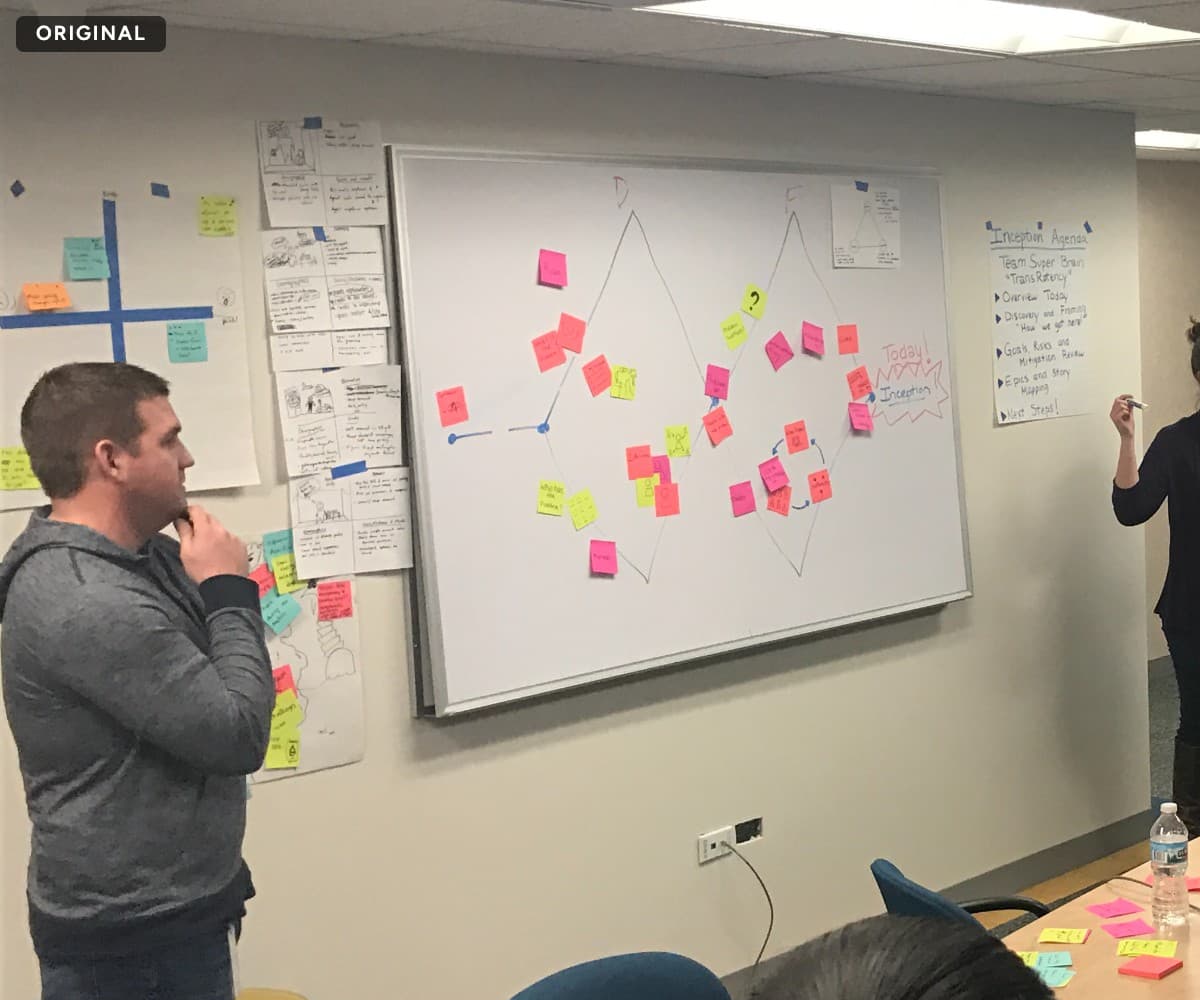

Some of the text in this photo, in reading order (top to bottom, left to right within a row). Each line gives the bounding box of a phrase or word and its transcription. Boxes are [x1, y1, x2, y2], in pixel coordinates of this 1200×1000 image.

[991, 228, 1088, 247] Inception Agenda
[999, 254, 1085, 270] Team Super Brain
[1043, 290, 1068, 303] Today
[1005, 310, 1040, 324] Discovery
[1044, 309, 1054, 317] and
[881, 328, 931, 366] Today!
[1019, 354, 1056, 368] Mitigation
[1005, 374, 1029, 388] Epics
[1033, 371, 1047, 381] and
[880, 386, 931, 402] Inception
